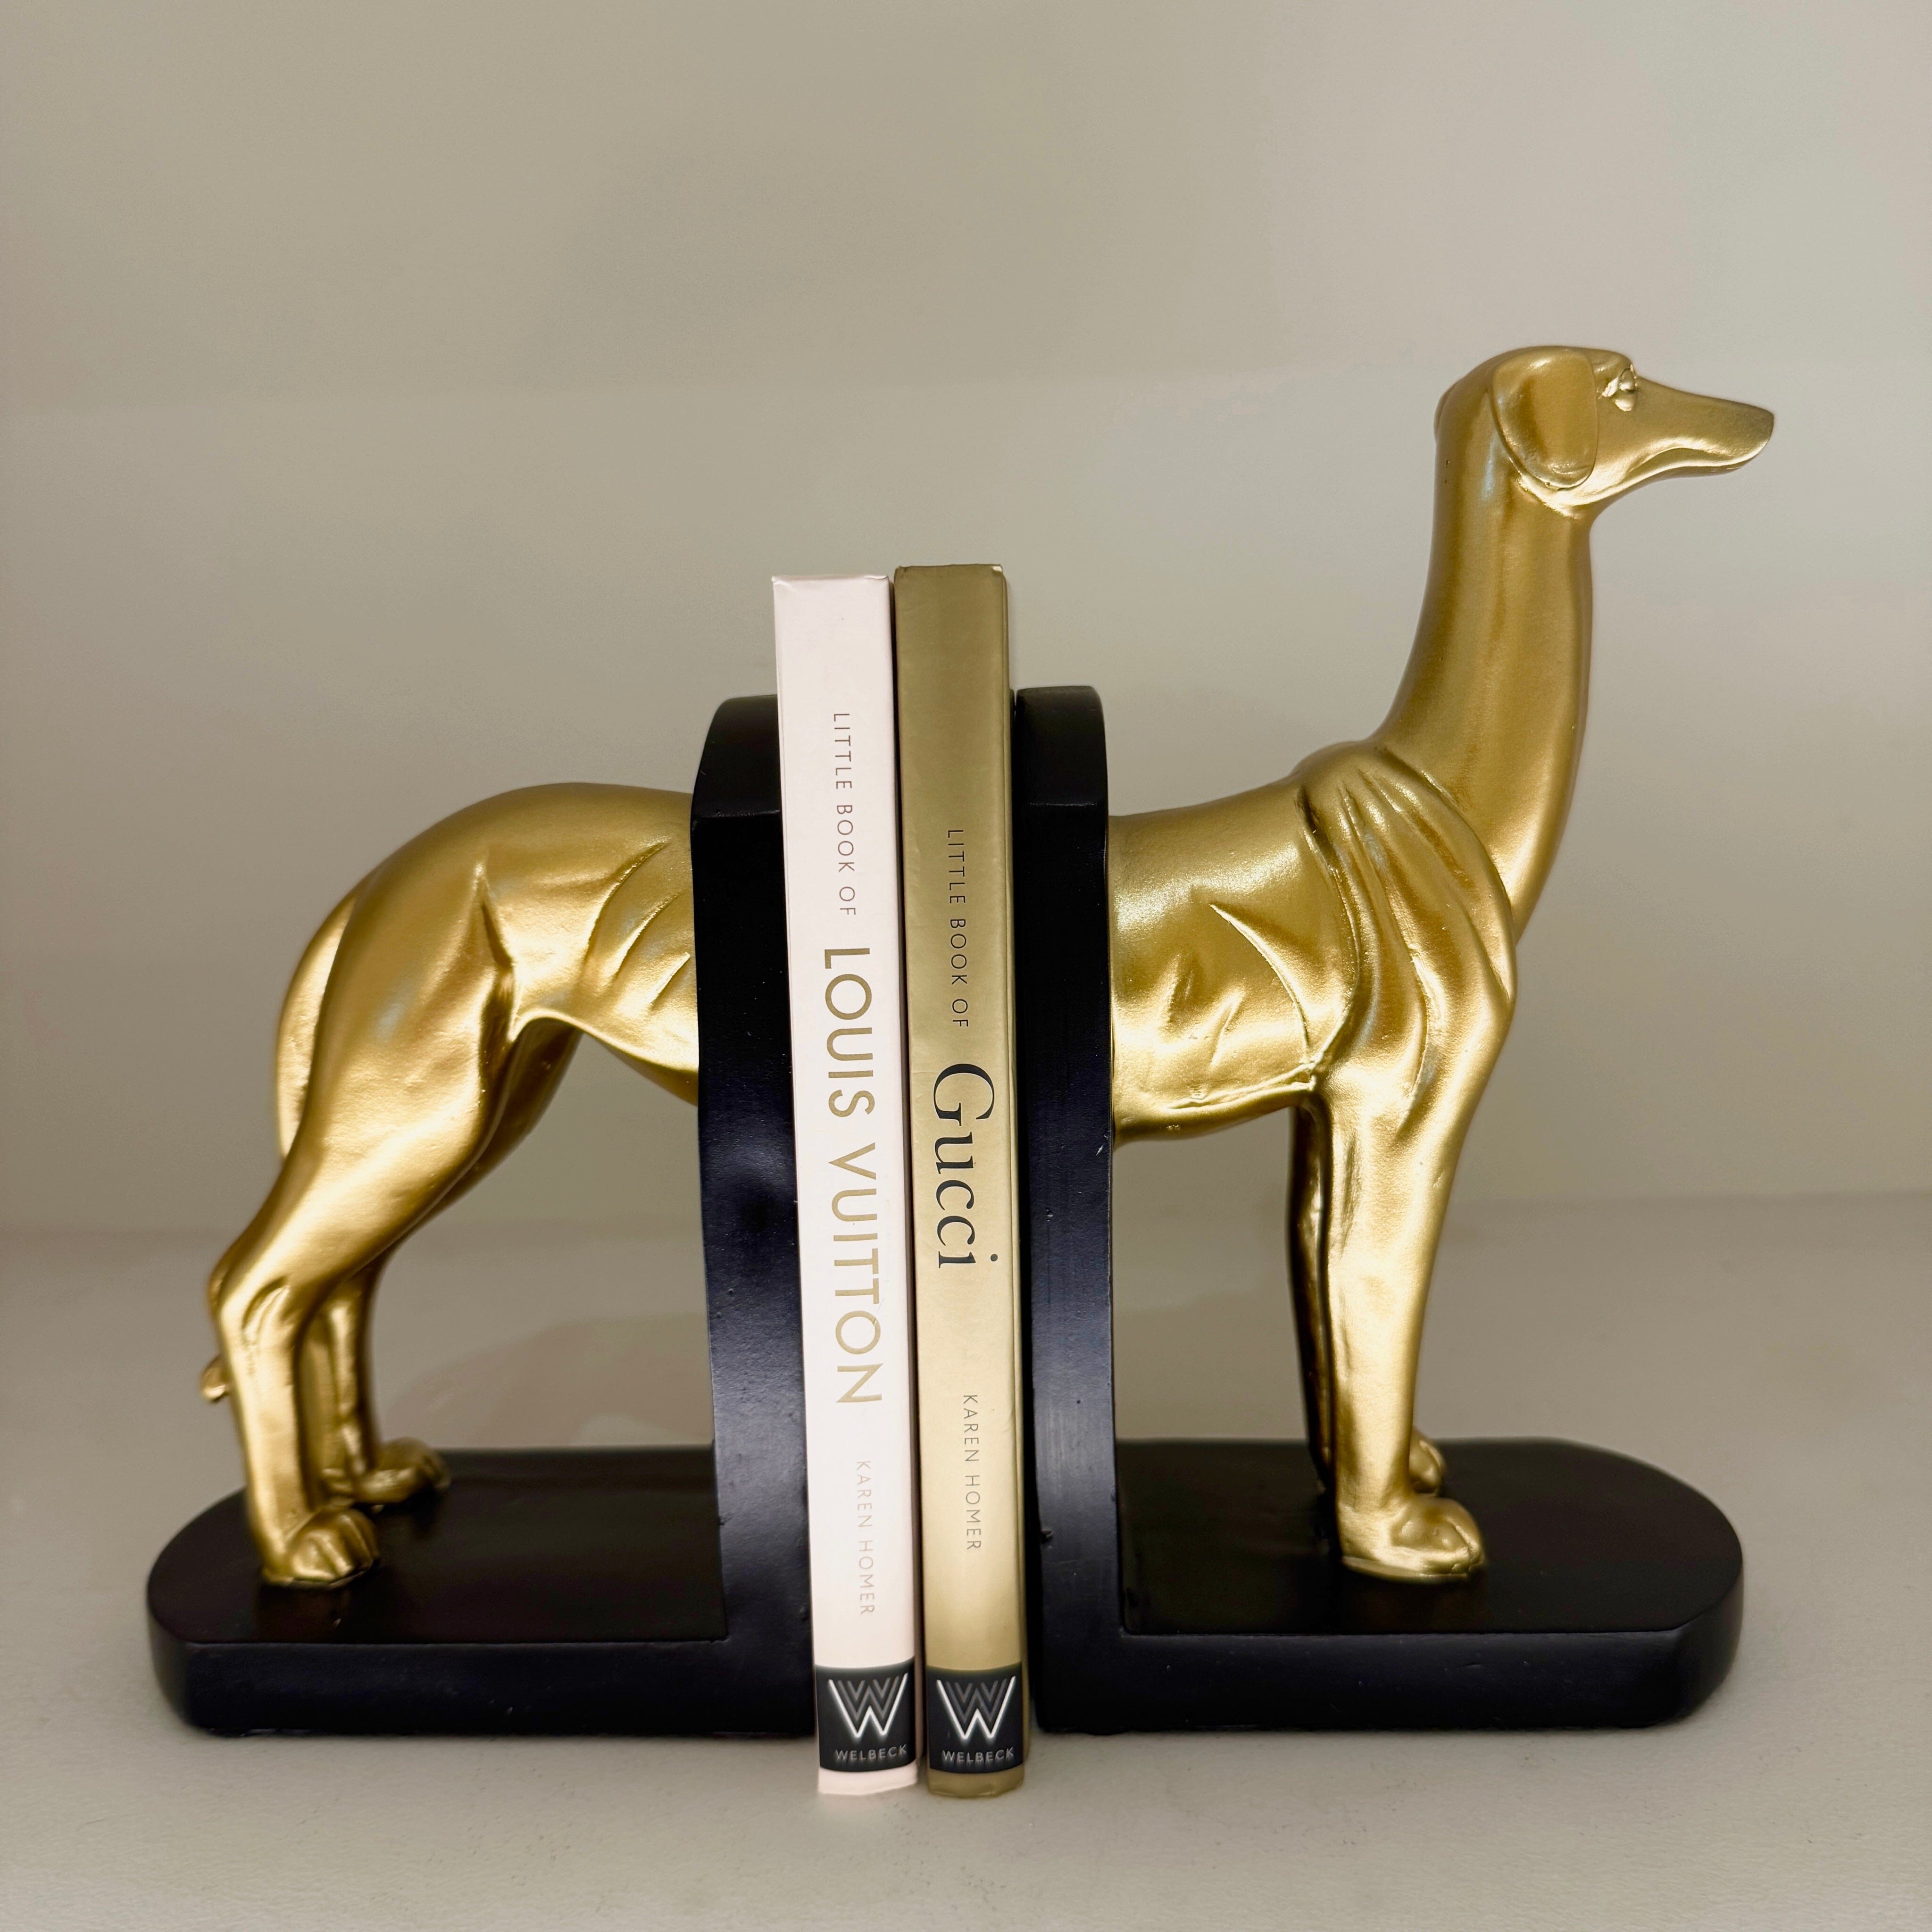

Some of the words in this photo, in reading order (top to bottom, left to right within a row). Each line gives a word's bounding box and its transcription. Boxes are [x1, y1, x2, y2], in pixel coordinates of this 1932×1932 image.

[833, 713, 853, 790] LITTLE
[836, 804, 855, 872] BOOK
[947, 829, 966, 904] LITTLE
[839, 886, 856, 915] OF
[949, 918, 968, 985] BOOK
[824, 948, 875, 1117] LOUIS
[951, 999, 969, 1027] OF
[933, 1063, 998, 1269] Gucci
[828, 1142, 883, 1403] VUITTON
[963, 1394, 980, 1462] KAREN
[856, 1460, 873, 1528] KAREN
[965, 1474, 982, 1550] HOMER
[858, 1540, 875, 1615] HOMER
[834, 1744, 907, 1762] WELBECK
[942, 1747, 1015, 1763] WELBECK
